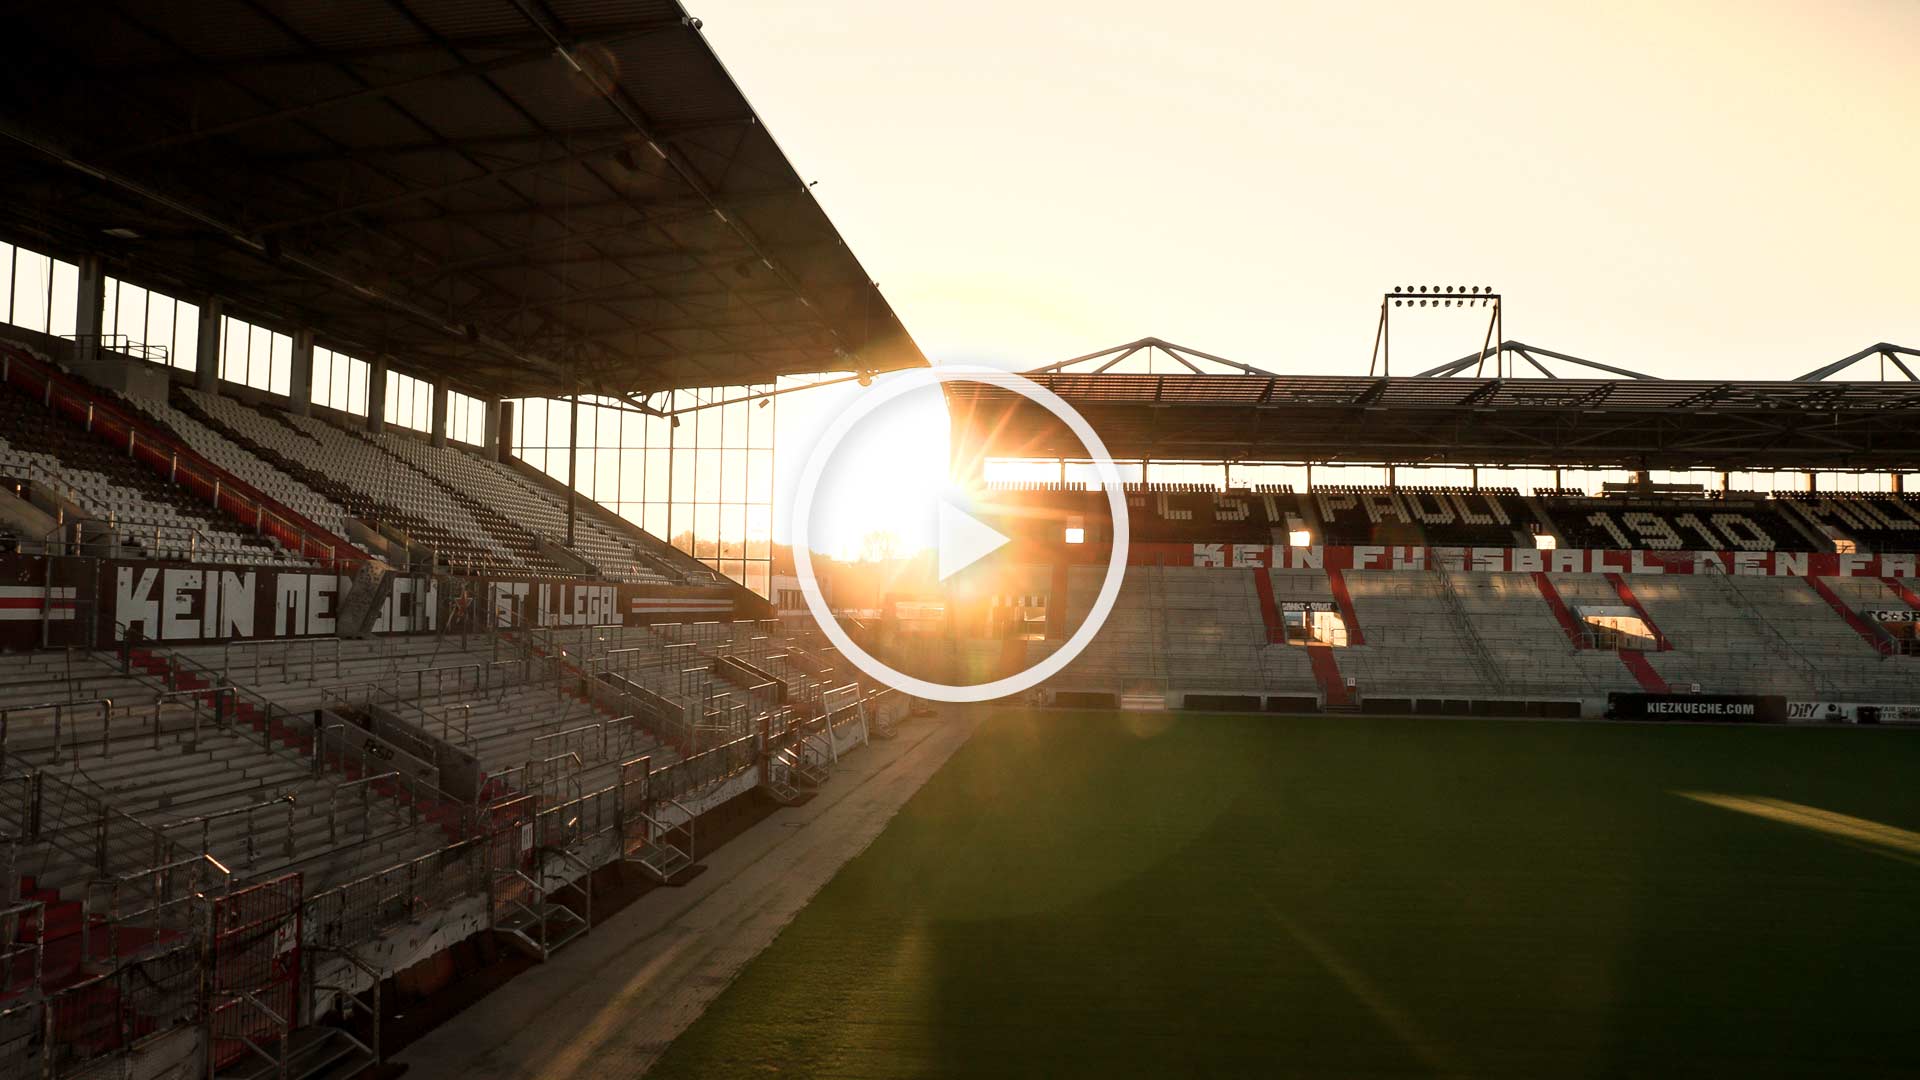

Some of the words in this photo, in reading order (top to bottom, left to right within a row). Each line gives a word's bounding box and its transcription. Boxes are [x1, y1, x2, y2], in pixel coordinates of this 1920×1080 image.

[1586, 511, 1776, 550] 1910
[1193, 543, 1323, 568] KEIN
[1353, 546, 1664, 574] FUSSBALL
[115, 566, 257, 641] KEIN
[274, 573, 437, 637] MECH
[537, 583, 623, 627] ILLEGAL
[1647, 702, 1755, 715] KIEZKUECHE.COM
